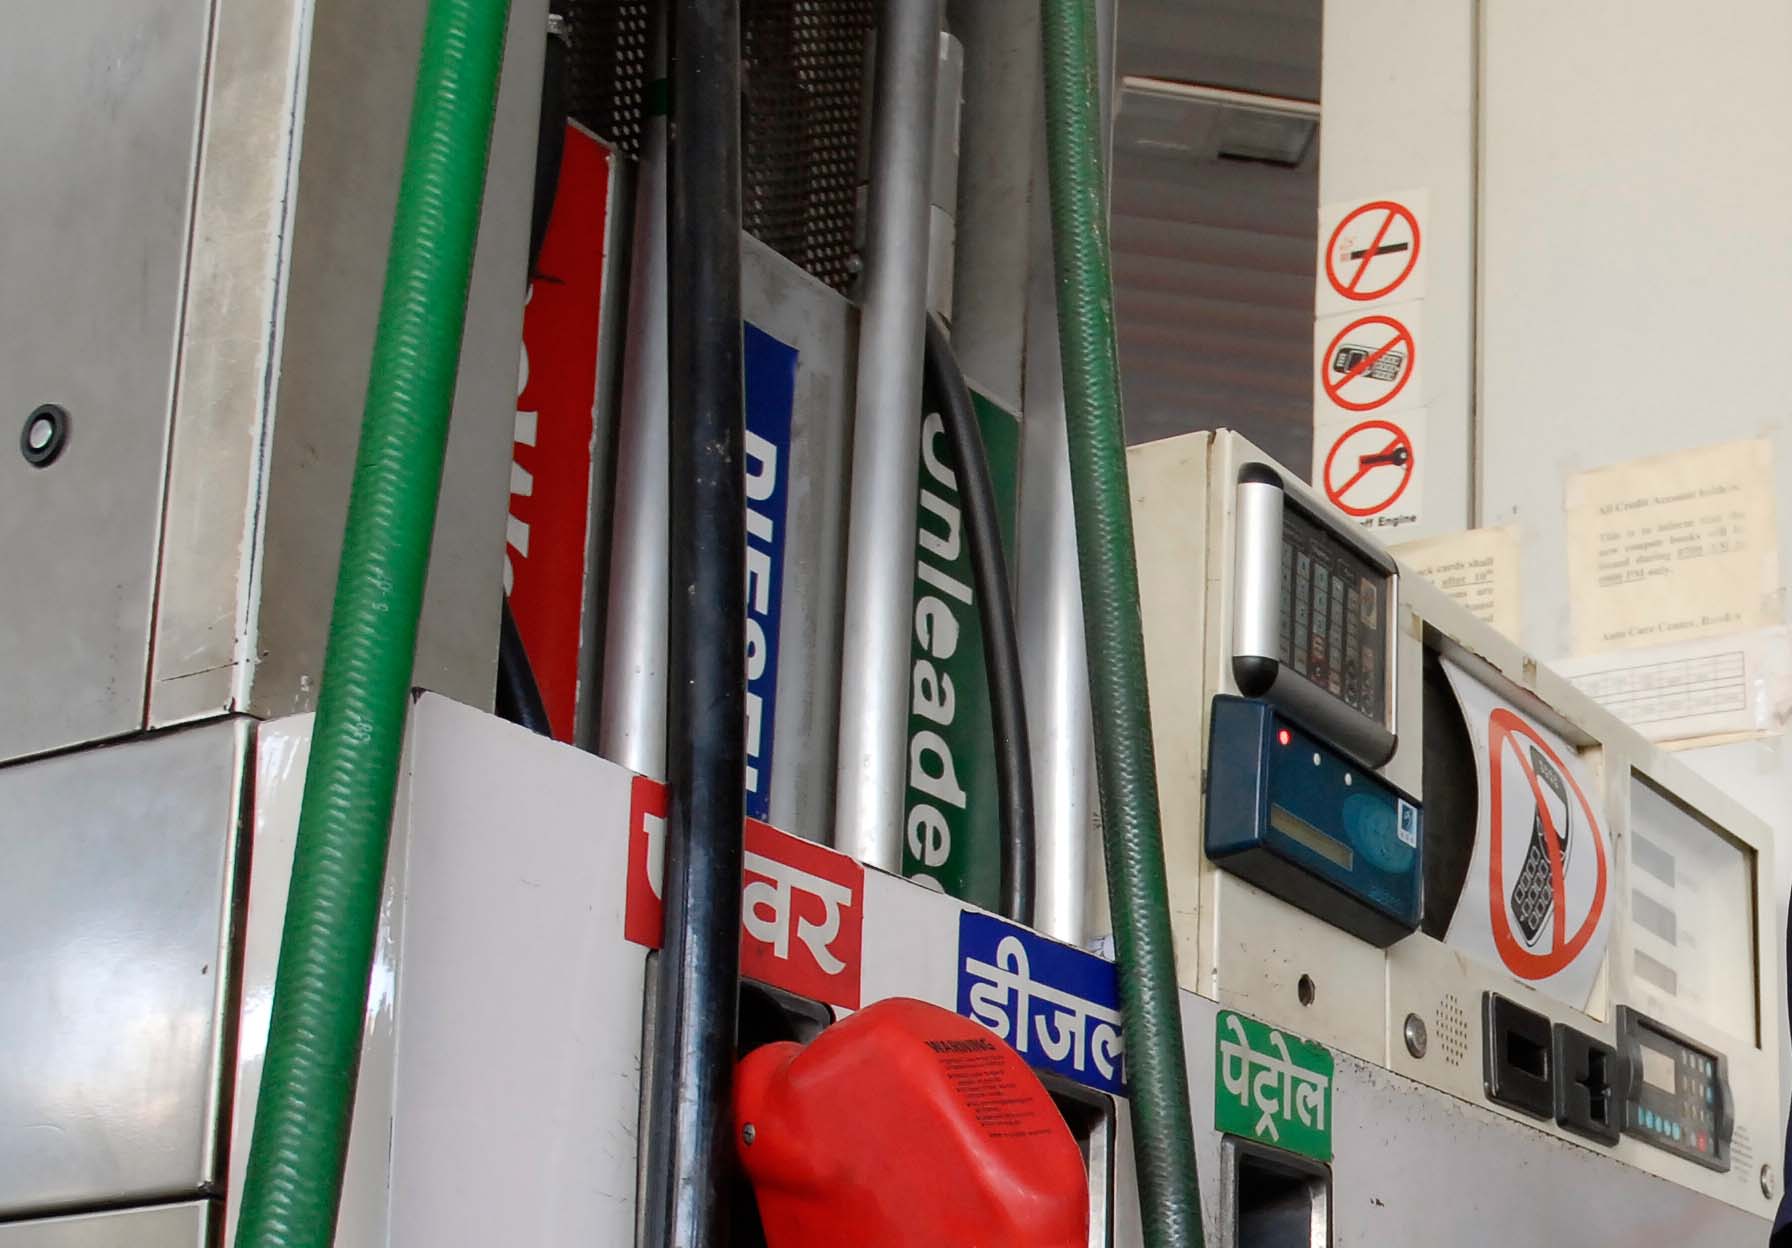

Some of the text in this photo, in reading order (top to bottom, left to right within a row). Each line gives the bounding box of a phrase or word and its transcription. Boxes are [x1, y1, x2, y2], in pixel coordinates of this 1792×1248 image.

[1378, 514, 1416, 527] Engine
[966, 936, 1128, 1084] डीजल
[1220, 1014, 1328, 1142] पेट्रोल
